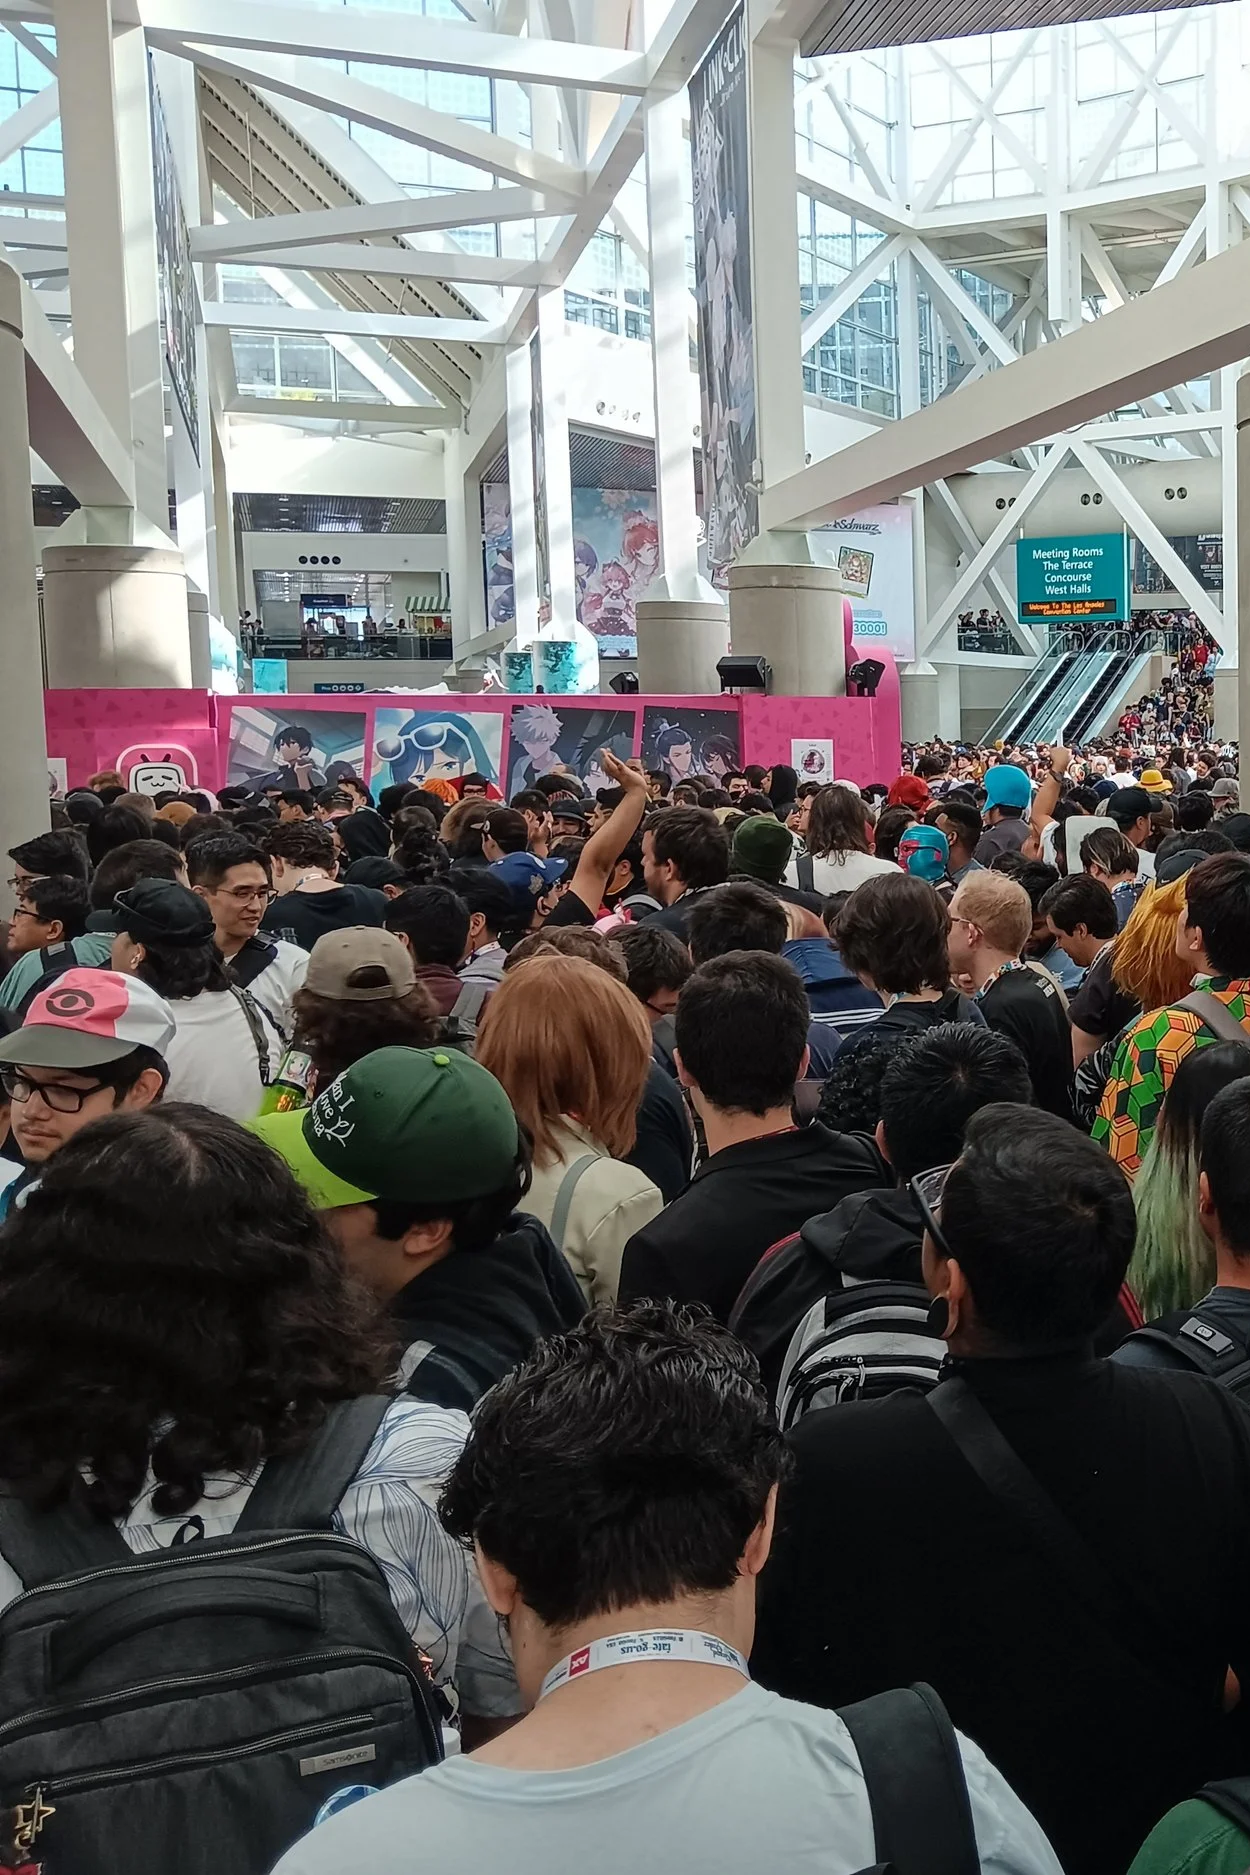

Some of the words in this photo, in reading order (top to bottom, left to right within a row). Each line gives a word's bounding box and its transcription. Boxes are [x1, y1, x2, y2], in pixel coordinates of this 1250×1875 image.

[1032, 547, 1070, 560] Meeting
[1072, 547, 1104, 558] Rooms
[1043, 560, 1060, 571] The
[1062, 560, 1094, 571] Terrace
[1044, 572, 1092, 583] Concourse
[1045, 585, 1068, 595] West
[1070, 583, 1092, 595] Halls
[1029, 603, 1050, 611] Welcome
[1052, 602, 1060, 610] To
[1043, 608, 1071, 616] Convention
[1073, 607, 1092, 615] Center
